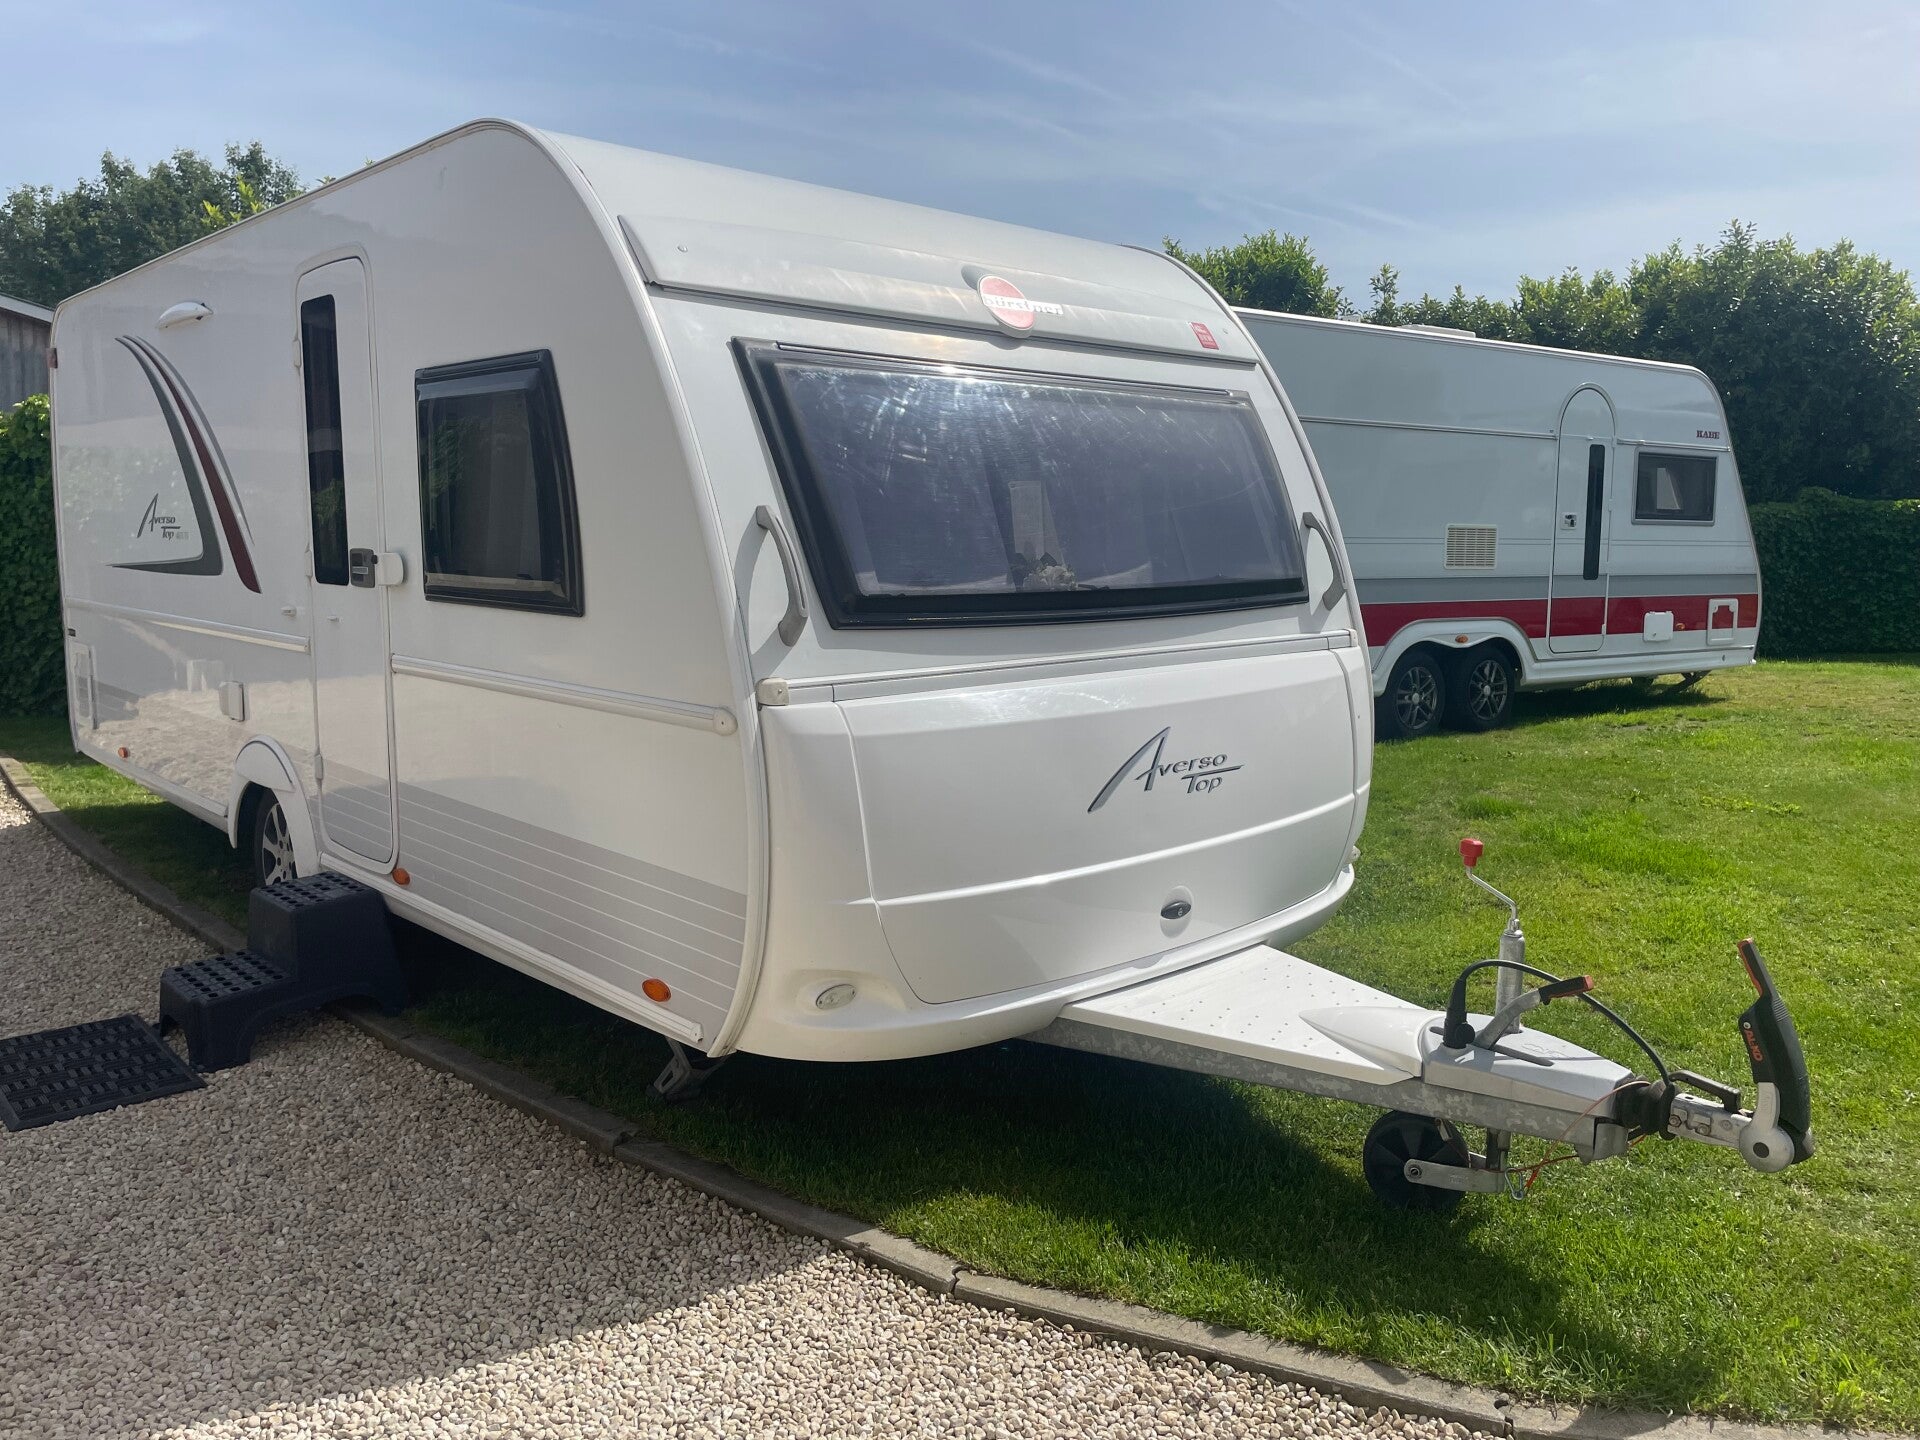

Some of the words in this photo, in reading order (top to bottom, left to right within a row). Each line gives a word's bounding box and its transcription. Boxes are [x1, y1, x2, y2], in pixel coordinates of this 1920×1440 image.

[137, 493, 176, 538] Averso
[161, 526, 181, 541] Top
[1087, 726, 1228, 813] Averso
[1181, 764, 1245, 794] Top
